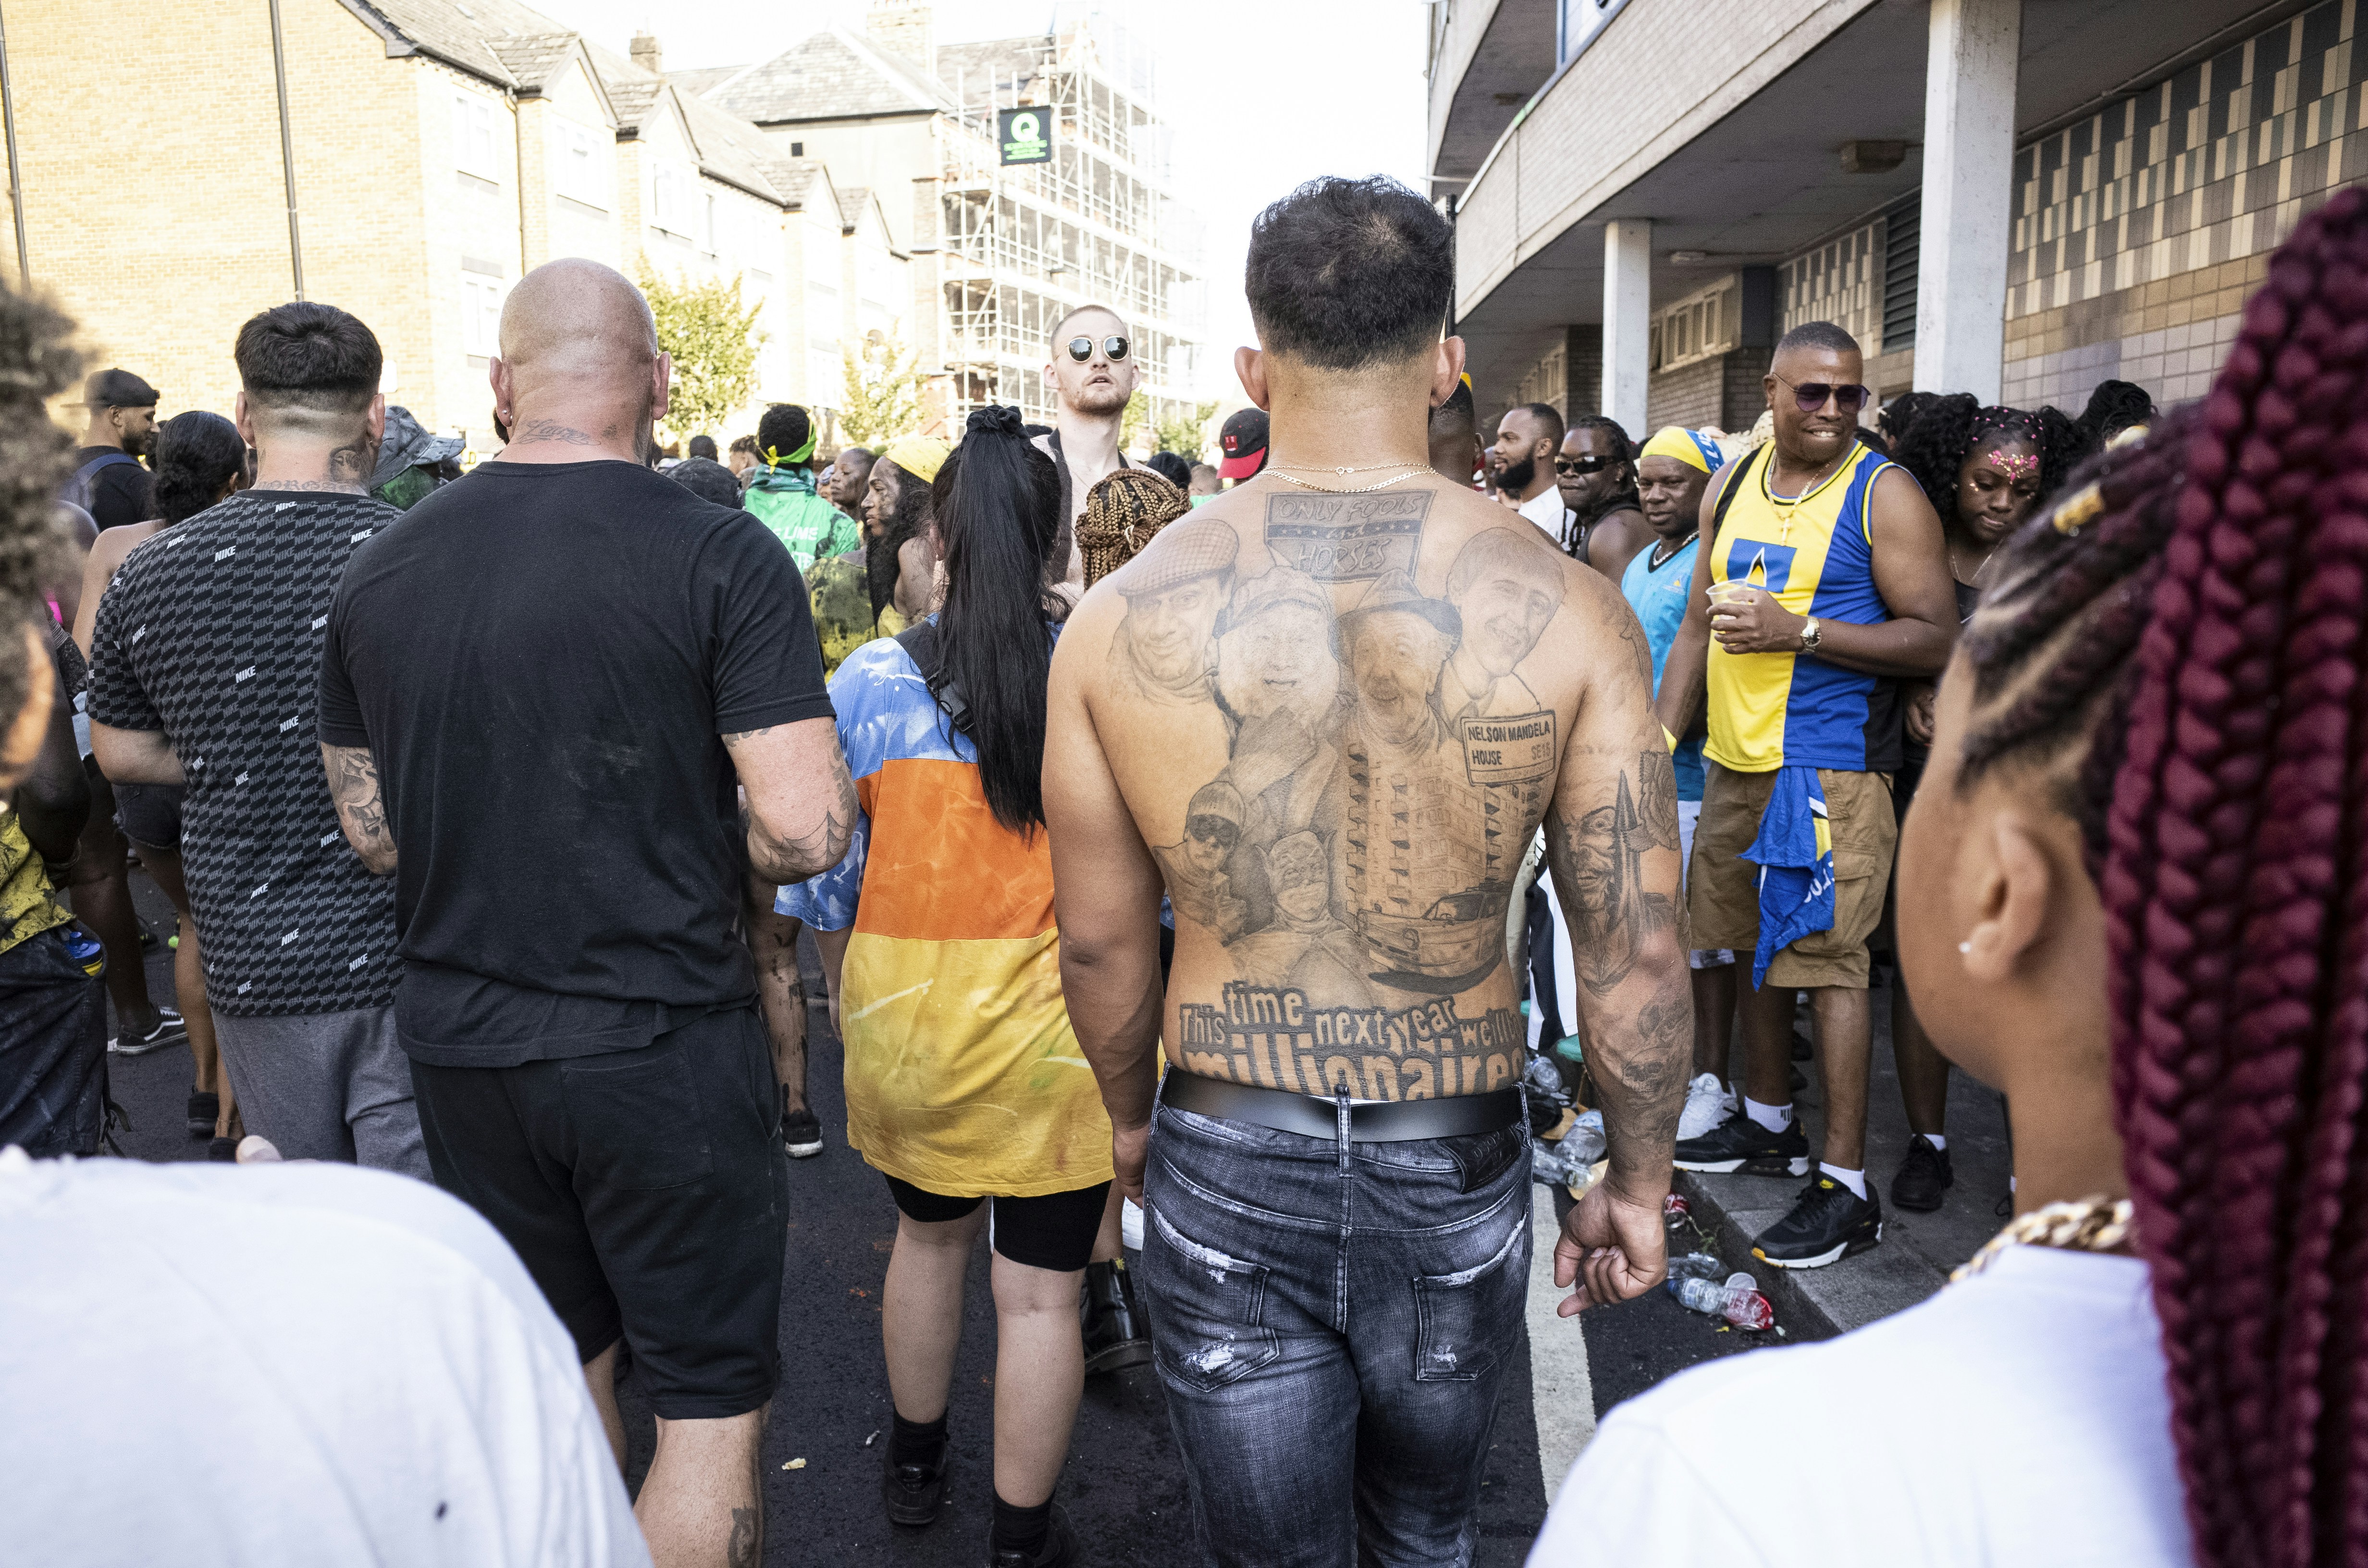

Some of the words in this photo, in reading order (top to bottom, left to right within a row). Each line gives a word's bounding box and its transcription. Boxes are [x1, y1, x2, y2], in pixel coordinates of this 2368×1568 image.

[1279, 500, 1342, 521] ONLY
[1347, 496, 1425, 521] FOOLS
[222, 516, 240, 531] NIKE
[240, 515, 258, 531] NIKE
[276, 513, 297, 528] NIKE
[295, 514, 318, 528] NIKE
[316, 514, 337, 529] NIKE
[335, 514, 356, 529] NIKE
[167, 533, 187, 550] NIKE
[200, 530, 219, 545] NIKE
[218, 529, 238, 545] NIKE
[237, 529, 257, 546] NIKE
[256, 529, 277, 546] NIKE
[275, 530, 296, 545] NIKE
[295, 530, 316, 545] NIKE
[314, 529, 335, 544] NIKE
[333, 529, 354, 544] NIKE
[351, 528, 372, 543] NIKE
[180, 546, 198, 562] NIKE
[215, 545, 236, 562] NIKE
[235, 546, 257, 563] NIKE
[255, 546, 276, 563] NIKE
[274, 546, 296, 563] NIKE
[294, 547, 315, 562] NIKE
[313, 546, 334, 561] NIKE
[331, 544, 352, 560] NIKE
[1298, 538, 1393, 573] HORSES
[177, 563, 196, 580] NIKE
[195, 563, 215, 579] NIKE
[214, 563, 234, 579] NIKE
[234, 563, 255, 579] NIKE
[254, 563, 275, 580] NIKE
[273, 564, 295, 580] NIKE
[294, 564, 315, 578] NIKE
[312, 563, 333, 577] NIKE
[176, 580, 194, 597] NIKE
[194, 580, 213, 597] NIKE
[213, 579, 233, 596] NIKE
[273, 580, 294, 597] NIKE
[293, 580, 314, 595] NIKE
[311, 579, 333, 594] NIKE
[193, 597, 212, 614] NIKE
[213, 597, 233, 613] NIKE
[233, 597, 253, 613] NIKE
[253, 597, 273, 614] NIKE
[273, 598, 292, 614] NIKE
[193, 615, 212, 632] NIKE
[212, 614, 232, 631] NIKE
[233, 614, 253, 631] NIKE
[253, 614, 273, 631] NIKE
[312, 614, 328, 631] NIK
[133, 624, 146, 645] NIKE
[177, 633, 194, 651] NIKE
[194, 632, 212, 650] NIKE
[213, 631, 233, 648] NIKE
[233, 631, 253, 648] NIKE
[254, 631, 274, 648] NIKE
[295, 630, 312, 647] NIKE
[161, 636, 177, 654] NIKE
[196, 649, 214, 668] NIKE
[214, 649, 234, 666] NIKE
[234, 649, 254, 665] NIKE
[255, 648, 274, 665] NIKE
[275, 648, 294, 665] NIKE
[295, 647, 312, 664] NIKE
[217, 666, 235, 684] NIKE
[235, 665, 256, 684] NIKE
[257, 665, 275, 682] NIKE
[276, 665, 295, 682] NIKE
[296, 664, 313, 681] NIKE
[219, 683, 238, 701] NIKE
[238, 684, 257, 700] NIKE
[258, 683, 277, 699] NIKE
[277, 682, 296, 698] NIKE
[297, 681, 314, 698] NIKE
[240, 701, 259, 718] NIKE
[259, 699, 279, 716] NIKE
[279, 698, 297, 715] NIKE
[298, 698, 315, 714] NIKE
[241, 718, 260, 735] NIKE
[260, 717, 279, 734] NIKE
[280, 715, 298, 733] NIKE
[298, 715, 316, 732] NIKE
[1468, 725, 1507, 743] NELSON
[1507, 720, 1551, 742] MANDELA
[262, 734, 281, 750] NIKE
[282, 733, 299, 749] NIKE
[299, 732, 316, 749] NIKE
[284, 749, 299, 766] NIKE
[299, 749, 317, 766] NIKE
[1471, 749, 1503, 765] HOUSE
[234, 771, 249, 786] NIKE
[285, 766, 300, 783] NIKE
[300, 766, 317, 783] NIKE
[285, 783, 300, 800] NIKE
[301, 783, 318, 800] NIKE
[236, 804, 251, 819] NIKE
[286, 799, 302, 817] NIKE
[301, 799, 318, 816] NIKE
[286, 816, 302, 833] NIKE
[302, 815, 319, 833] NIKE
[287, 833, 303, 850] NIKE
[303, 832, 320, 849] NIKE
[321, 830, 339, 847] NIKE
[352, 876, 369, 893] NIKE
[265, 913, 283, 930] NIKE
[316, 908, 333, 925] NIKE
[298, 927, 315, 943] NIKE
[315, 925, 331, 942] NIKE
[331, 923, 348, 940] NIKE
[367, 919, 384, 935] NIKE
[281, 928, 299, 946] NIKE
[368, 935, 385, 951] NIKE
[297, 943, 314, 960] NIKE
[314, 942, 330, 958] NIKE
[330, 940, 349, 957] NIKE
[348, 937, 367, 955] NIKE
[315, 957, 332, 976] NIKE
[332, 956, 349, 974] NIKE
[349, 953, 368, 972] NIKE
[369, 951, 386, 968] NIKE
[298, 959, 315, 978] NIKE
[370, 967, 387, 984] NIKE
[238, 980, 252, 994] NIKE
[268, 980, 283, 993] NIKE
[334, 972, 352, 991] NIKE
[352, 970, 369, 987] NIKE
[337, 988, 354, 1005] NIKE
[354, 985, 371, 1003] NIKE
[372, 982, 390, 1000] NIKE
[1182, 1005, 1226, 1045] This
[1226, 983, 1305, 1027] time
[1314, 1009, 1386, 1046] next
[1390, 998, 1456, 1052] year
